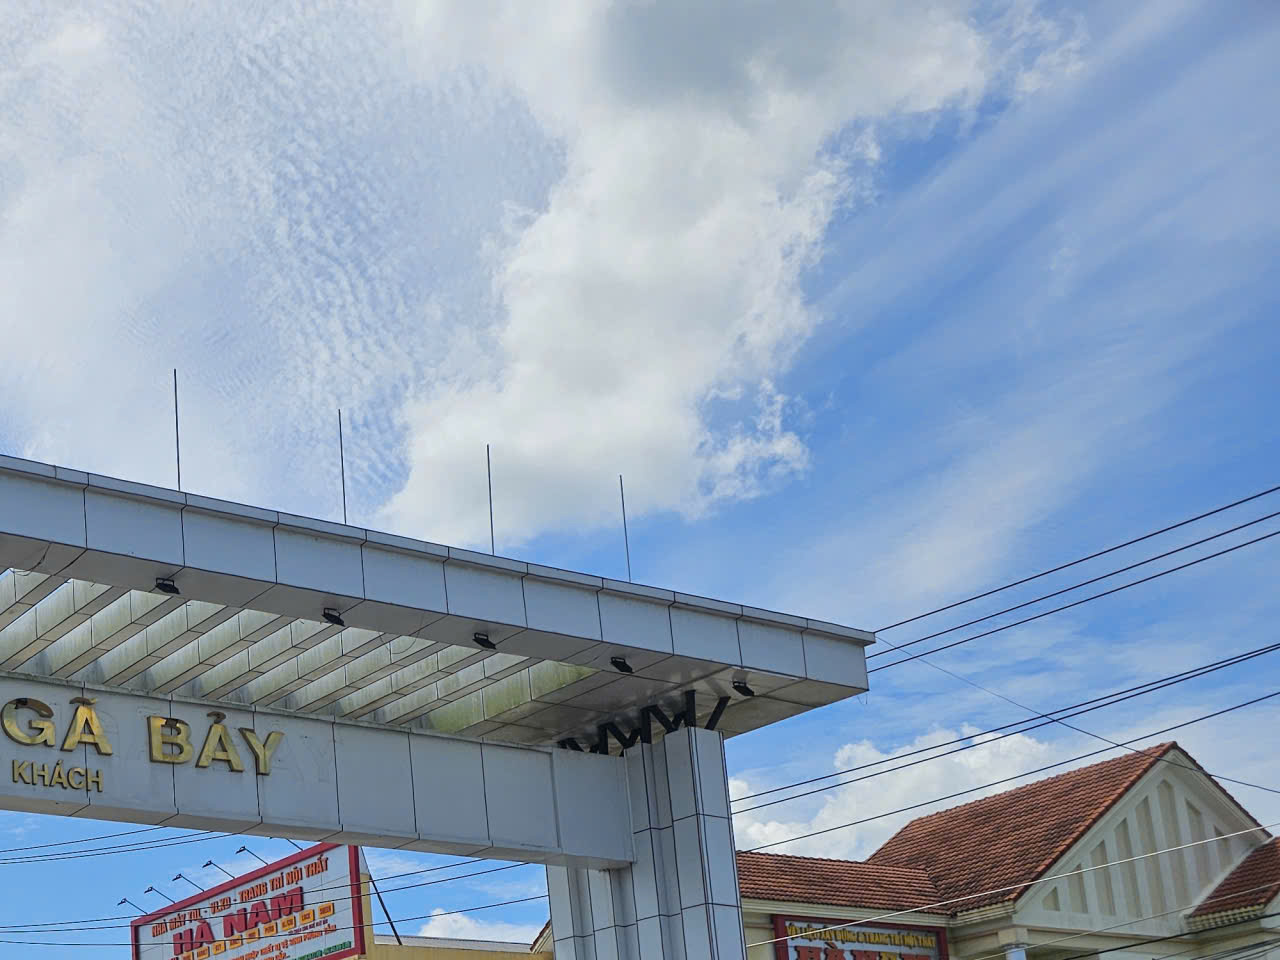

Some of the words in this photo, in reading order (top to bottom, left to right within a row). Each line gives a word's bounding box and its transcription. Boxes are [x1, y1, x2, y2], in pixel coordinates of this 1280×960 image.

[147, 710, 285, 777] BẢY
[11, 754, 104, 793] KHÁCH
[238, 881, 268, 902] TRANG
[269, 871, 284, 891] TRÍ
[285, 866, 303, 885] NỘI
[303, 853, 329, 878] THẤT
[173, 916, 216, 956] HÀ
[223, 886, 305, 938] NAM
